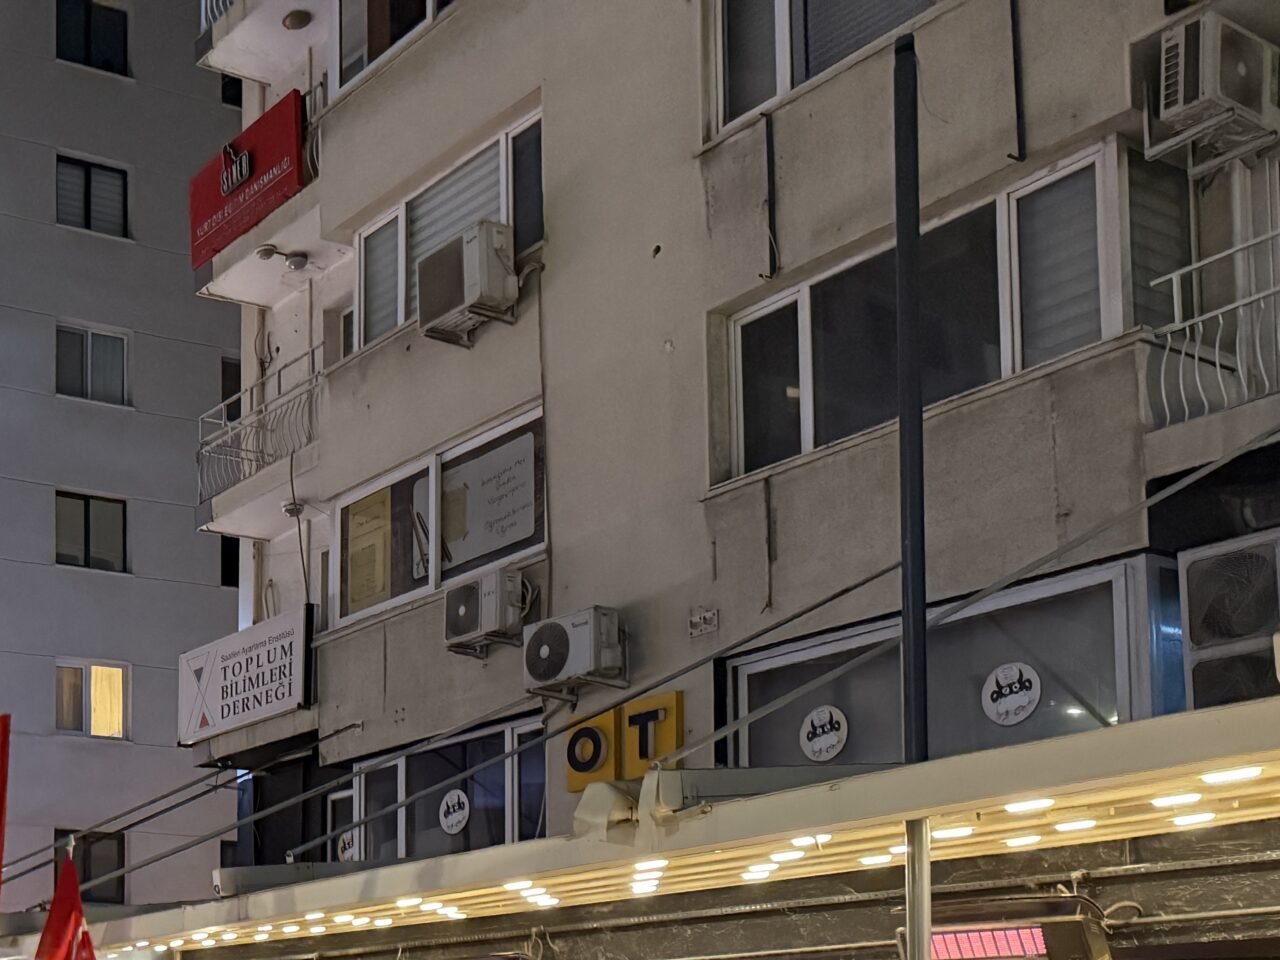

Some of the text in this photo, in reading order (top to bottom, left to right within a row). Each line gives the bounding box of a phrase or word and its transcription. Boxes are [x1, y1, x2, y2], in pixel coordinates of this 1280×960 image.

[220, 641, 294, 681] TOPLUM
[221, 657, 294, 701] BİLİMLERİ
[220, 678, 294, 720] DERNEĞİ
